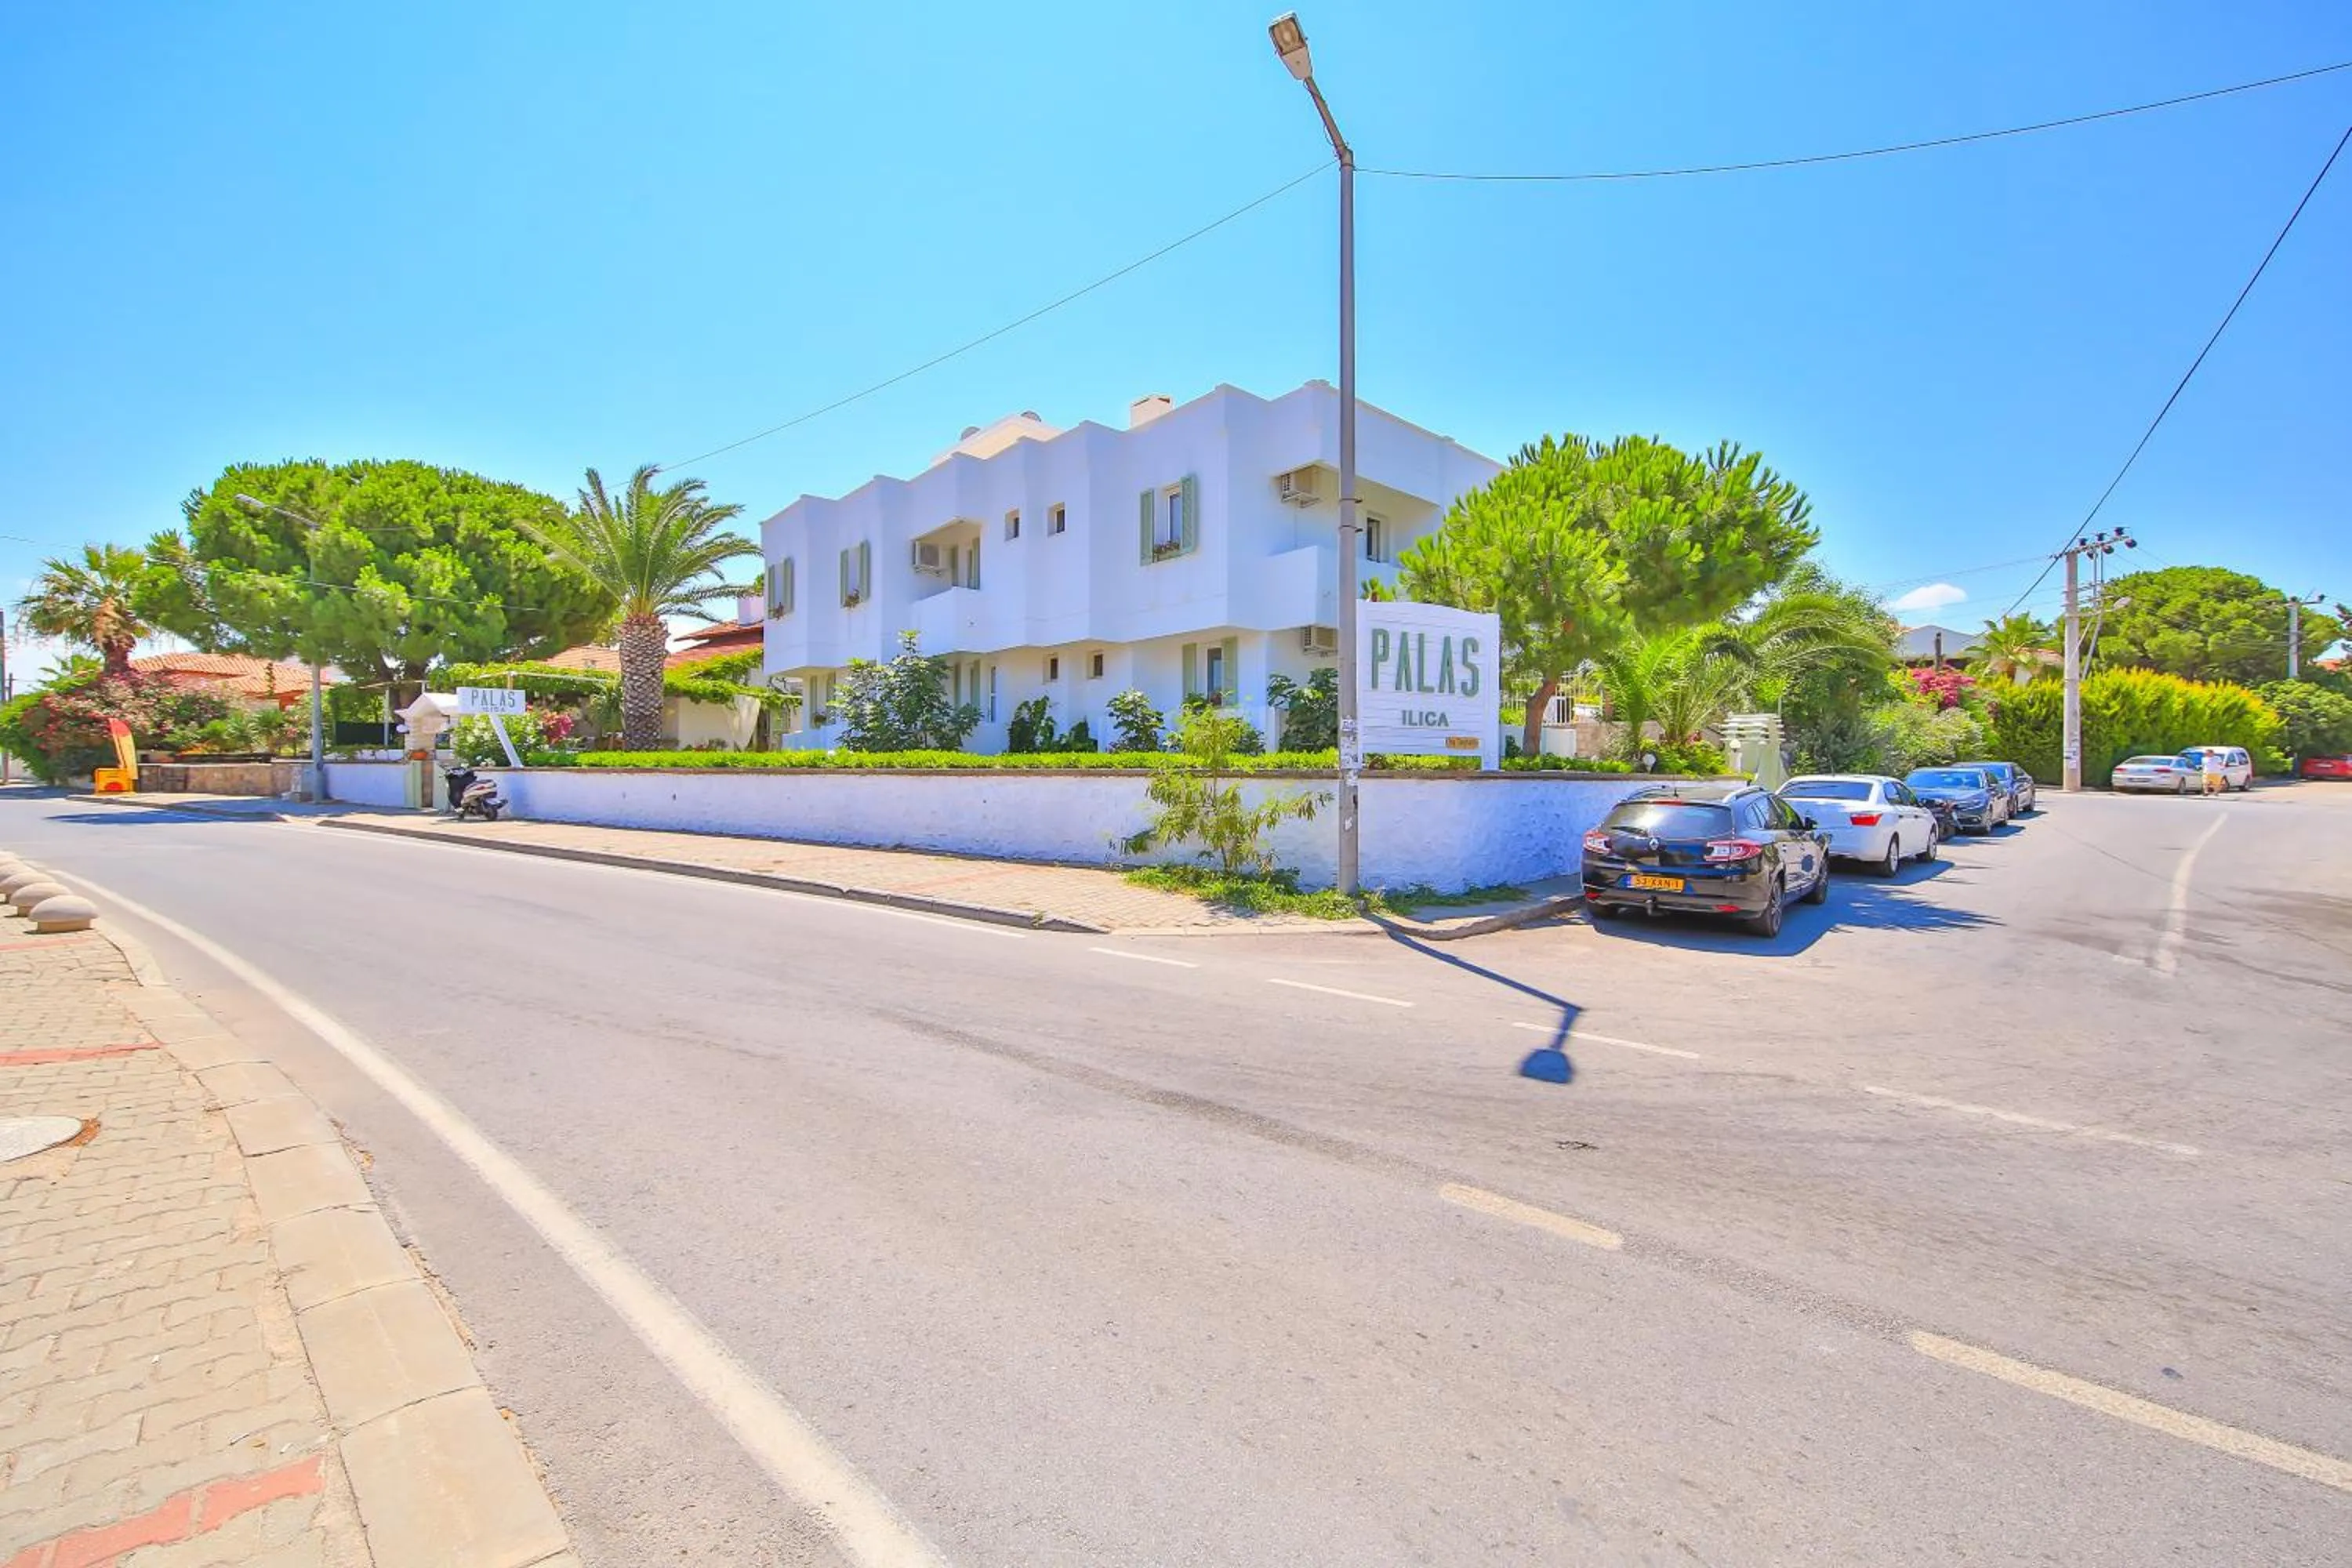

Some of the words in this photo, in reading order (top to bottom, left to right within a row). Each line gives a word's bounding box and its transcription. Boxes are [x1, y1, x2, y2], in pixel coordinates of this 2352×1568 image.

[1371, 628, 1479, 697] PALAS
[471, 689, 515, 708] PALAS
[1402, 710, 1449, 727] ILICA
